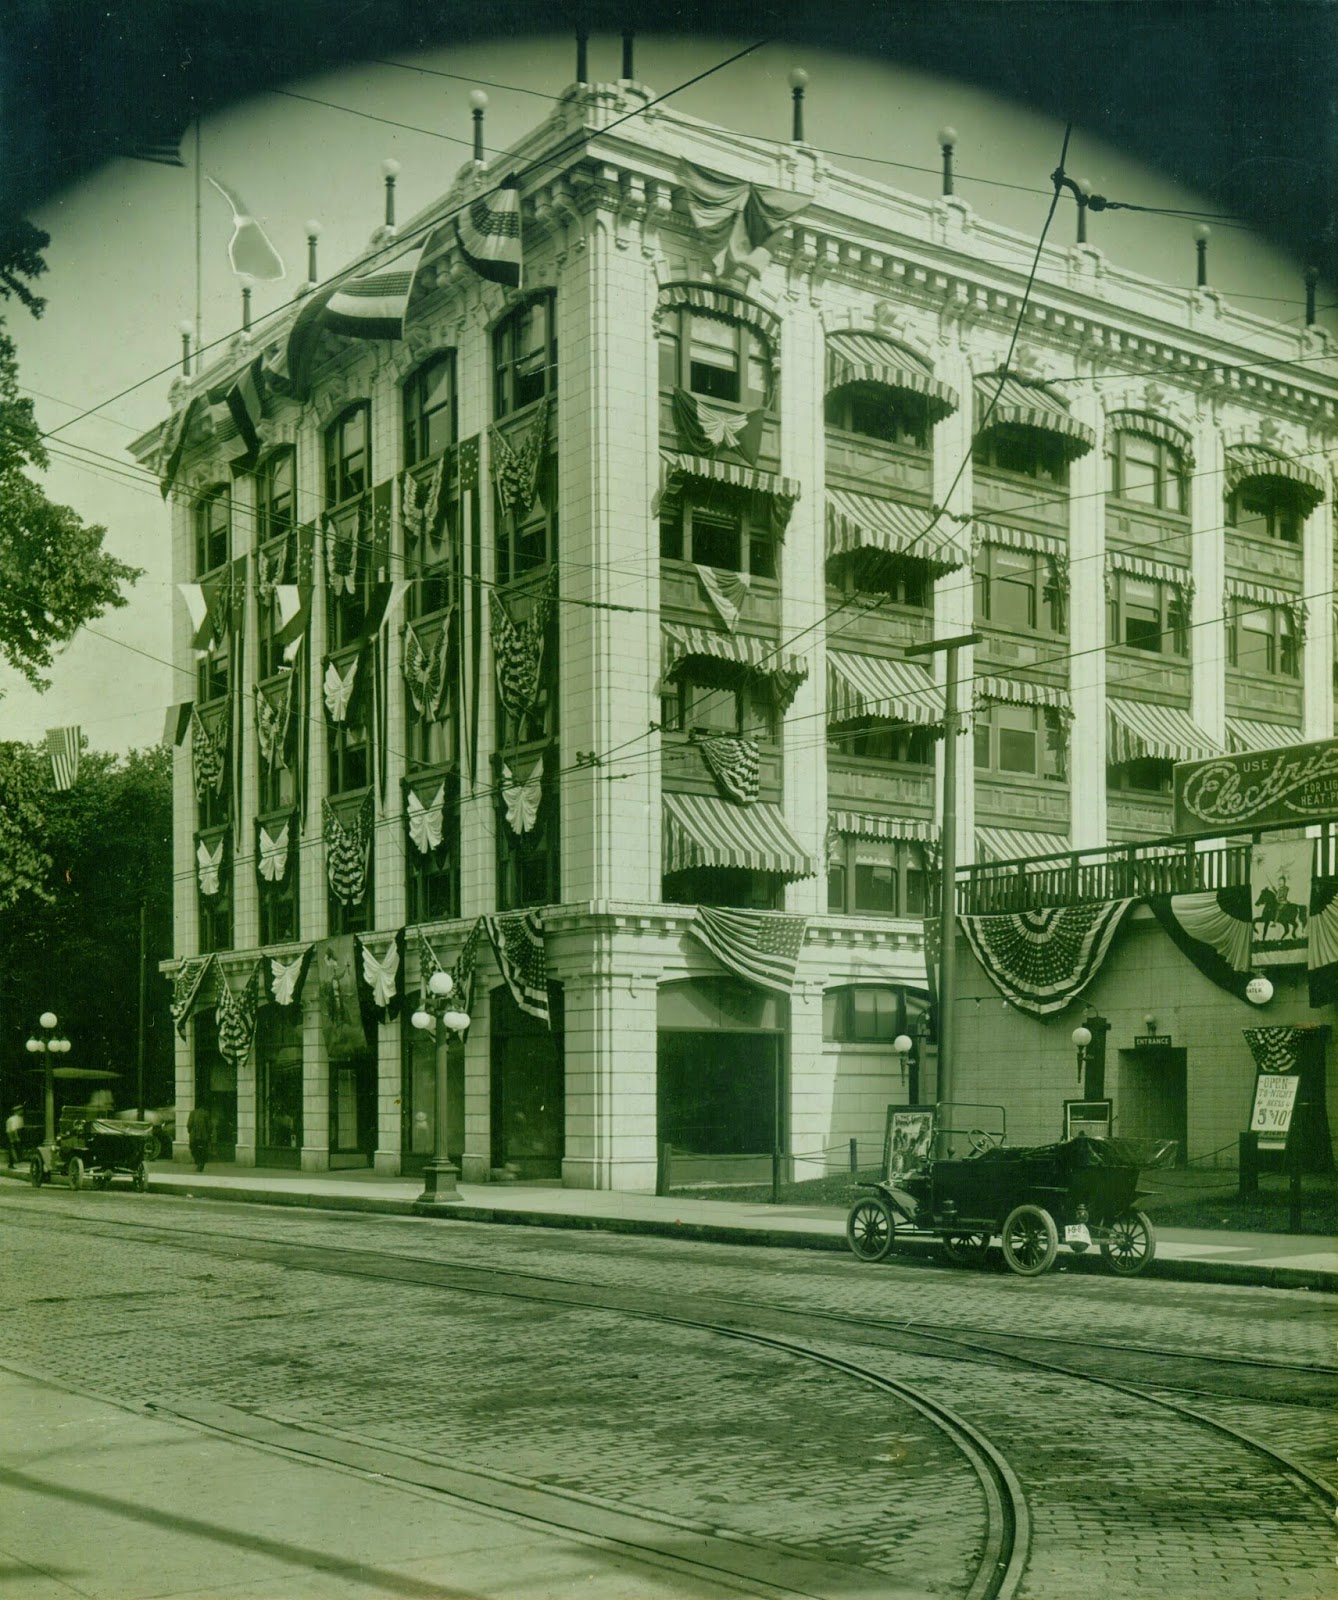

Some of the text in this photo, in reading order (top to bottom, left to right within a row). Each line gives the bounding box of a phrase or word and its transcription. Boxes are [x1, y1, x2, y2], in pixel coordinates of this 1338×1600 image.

[1243, 759, 1269, 773] USE
[1304, 782, 1321, 795] FOR
[1136, 1038, 1169, 1046] ENTRANCE
[1263, 1077, 1289, 1090] OPEN
[1257, 1108, 1267, 1125] 5
